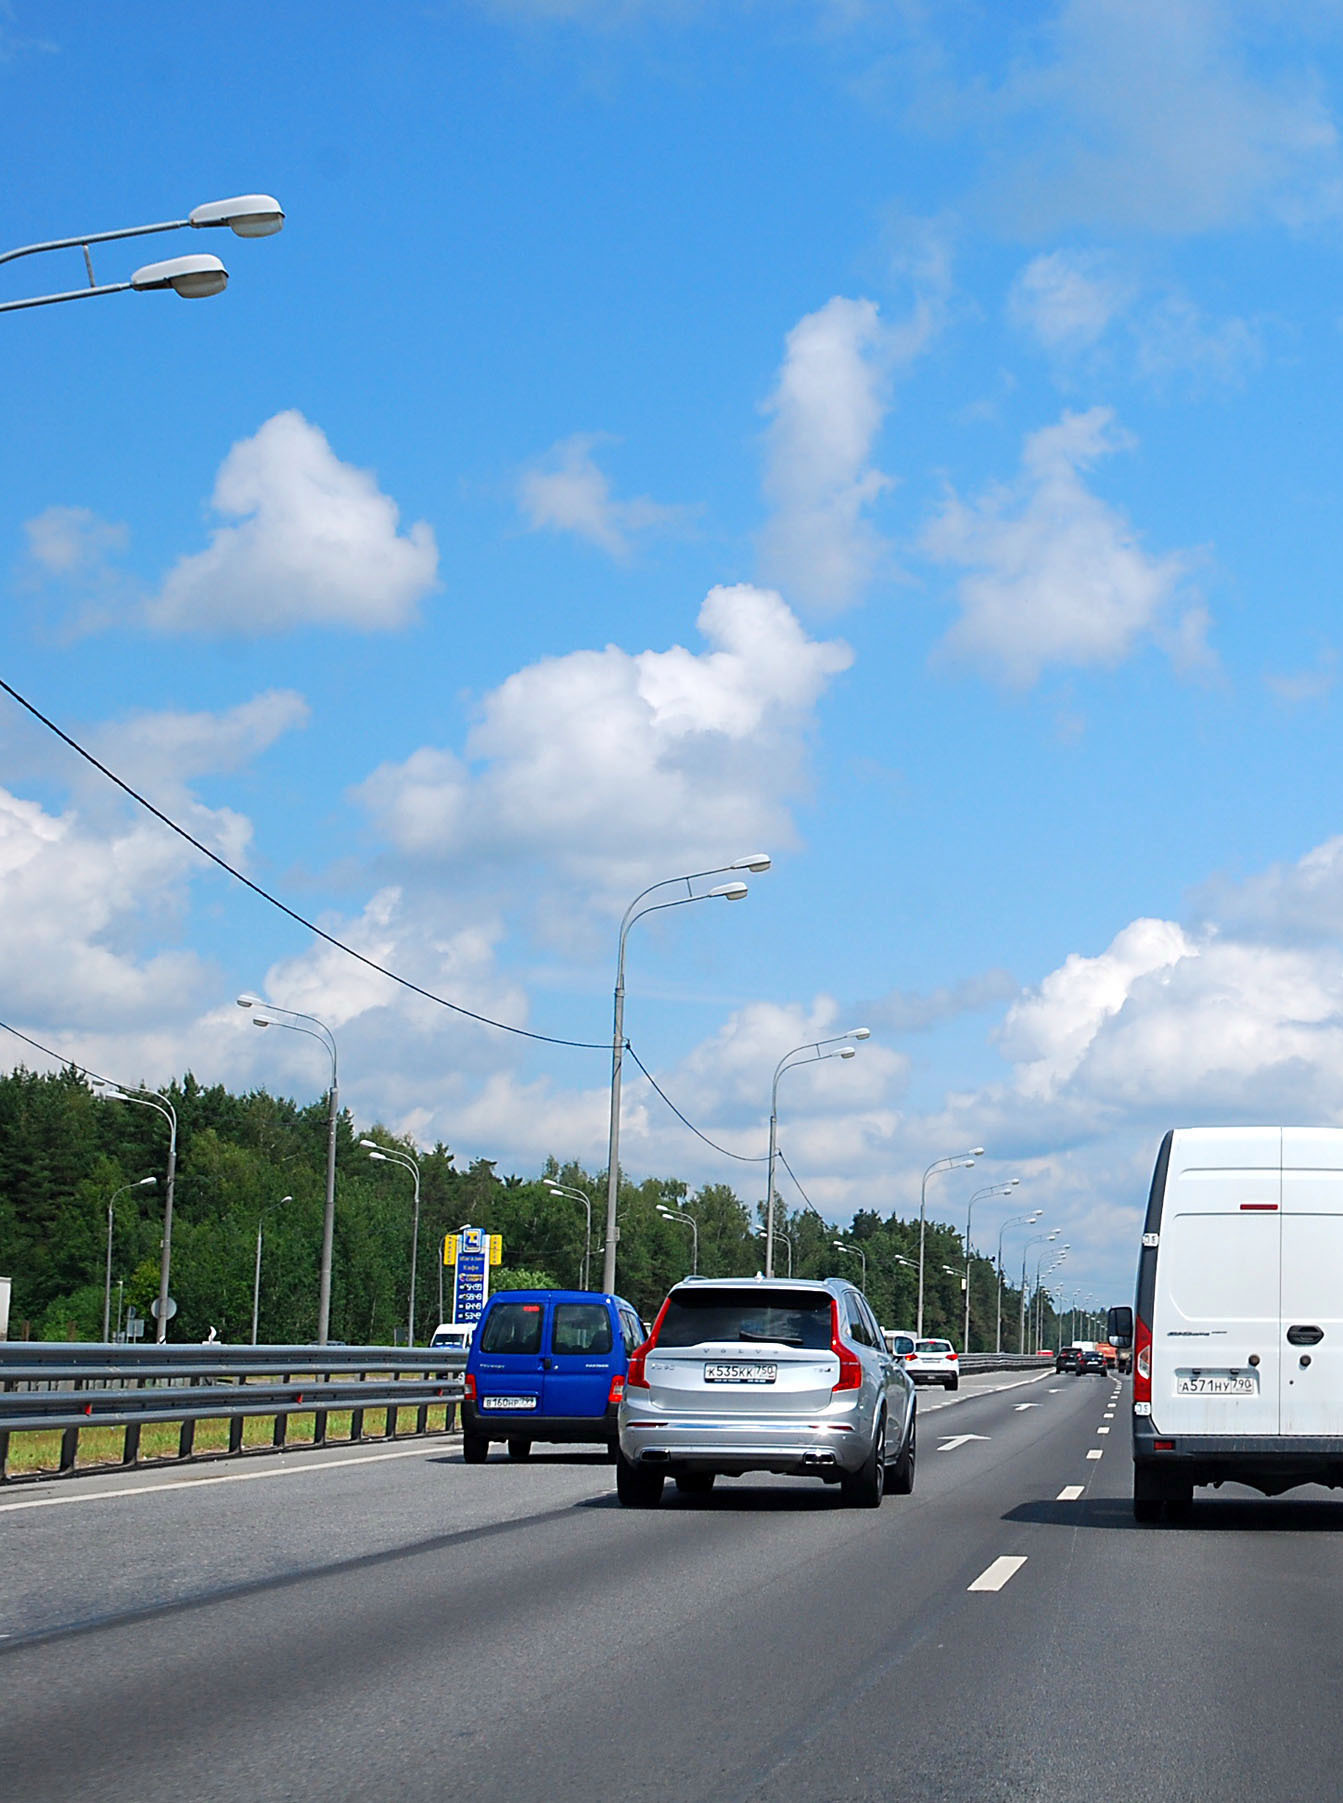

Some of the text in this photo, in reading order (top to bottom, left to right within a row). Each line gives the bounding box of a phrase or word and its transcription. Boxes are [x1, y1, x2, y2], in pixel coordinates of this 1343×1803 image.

[707, 1365, 753, 1377] К535КК
[1181, 1379, 1251, 1392] А571НУ 790
